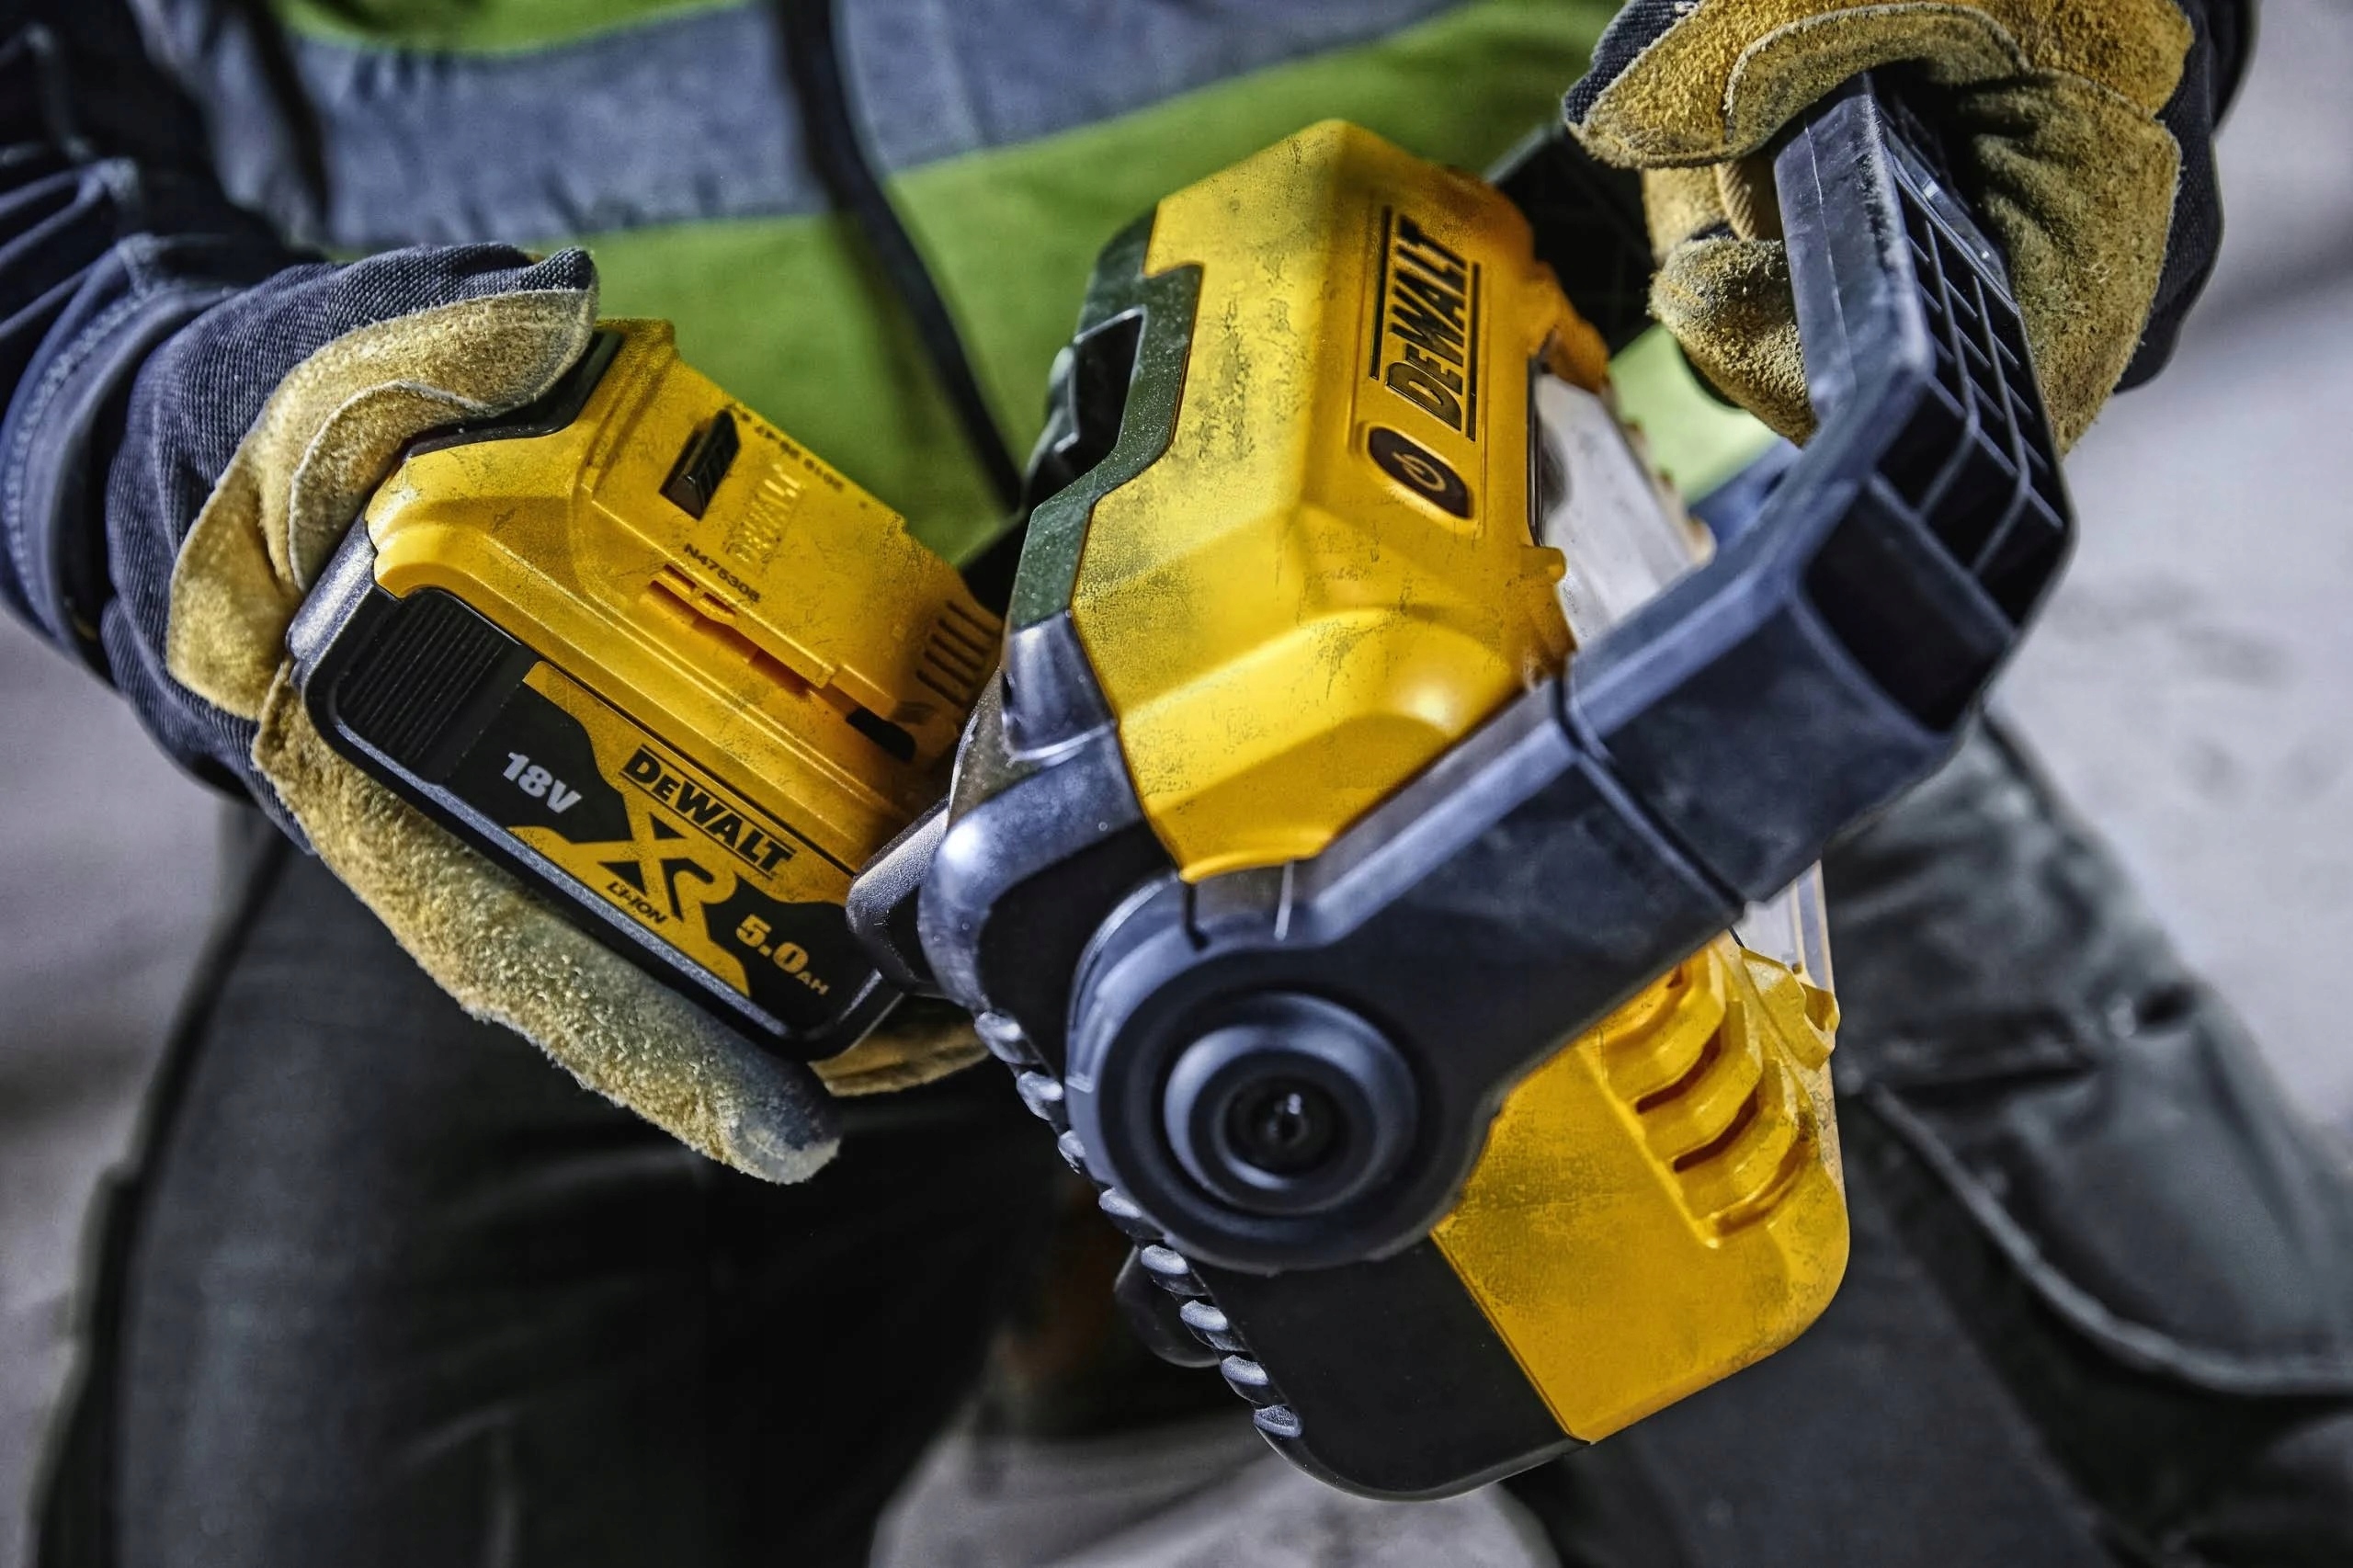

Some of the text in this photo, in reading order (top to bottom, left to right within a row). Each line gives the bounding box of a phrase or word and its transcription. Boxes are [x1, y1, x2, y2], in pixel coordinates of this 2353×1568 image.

[1385, 213, 1468, 433] DEWALT
[503, 752, 582, 814] 18V
[623, 746, 794, 873] DEWALT
